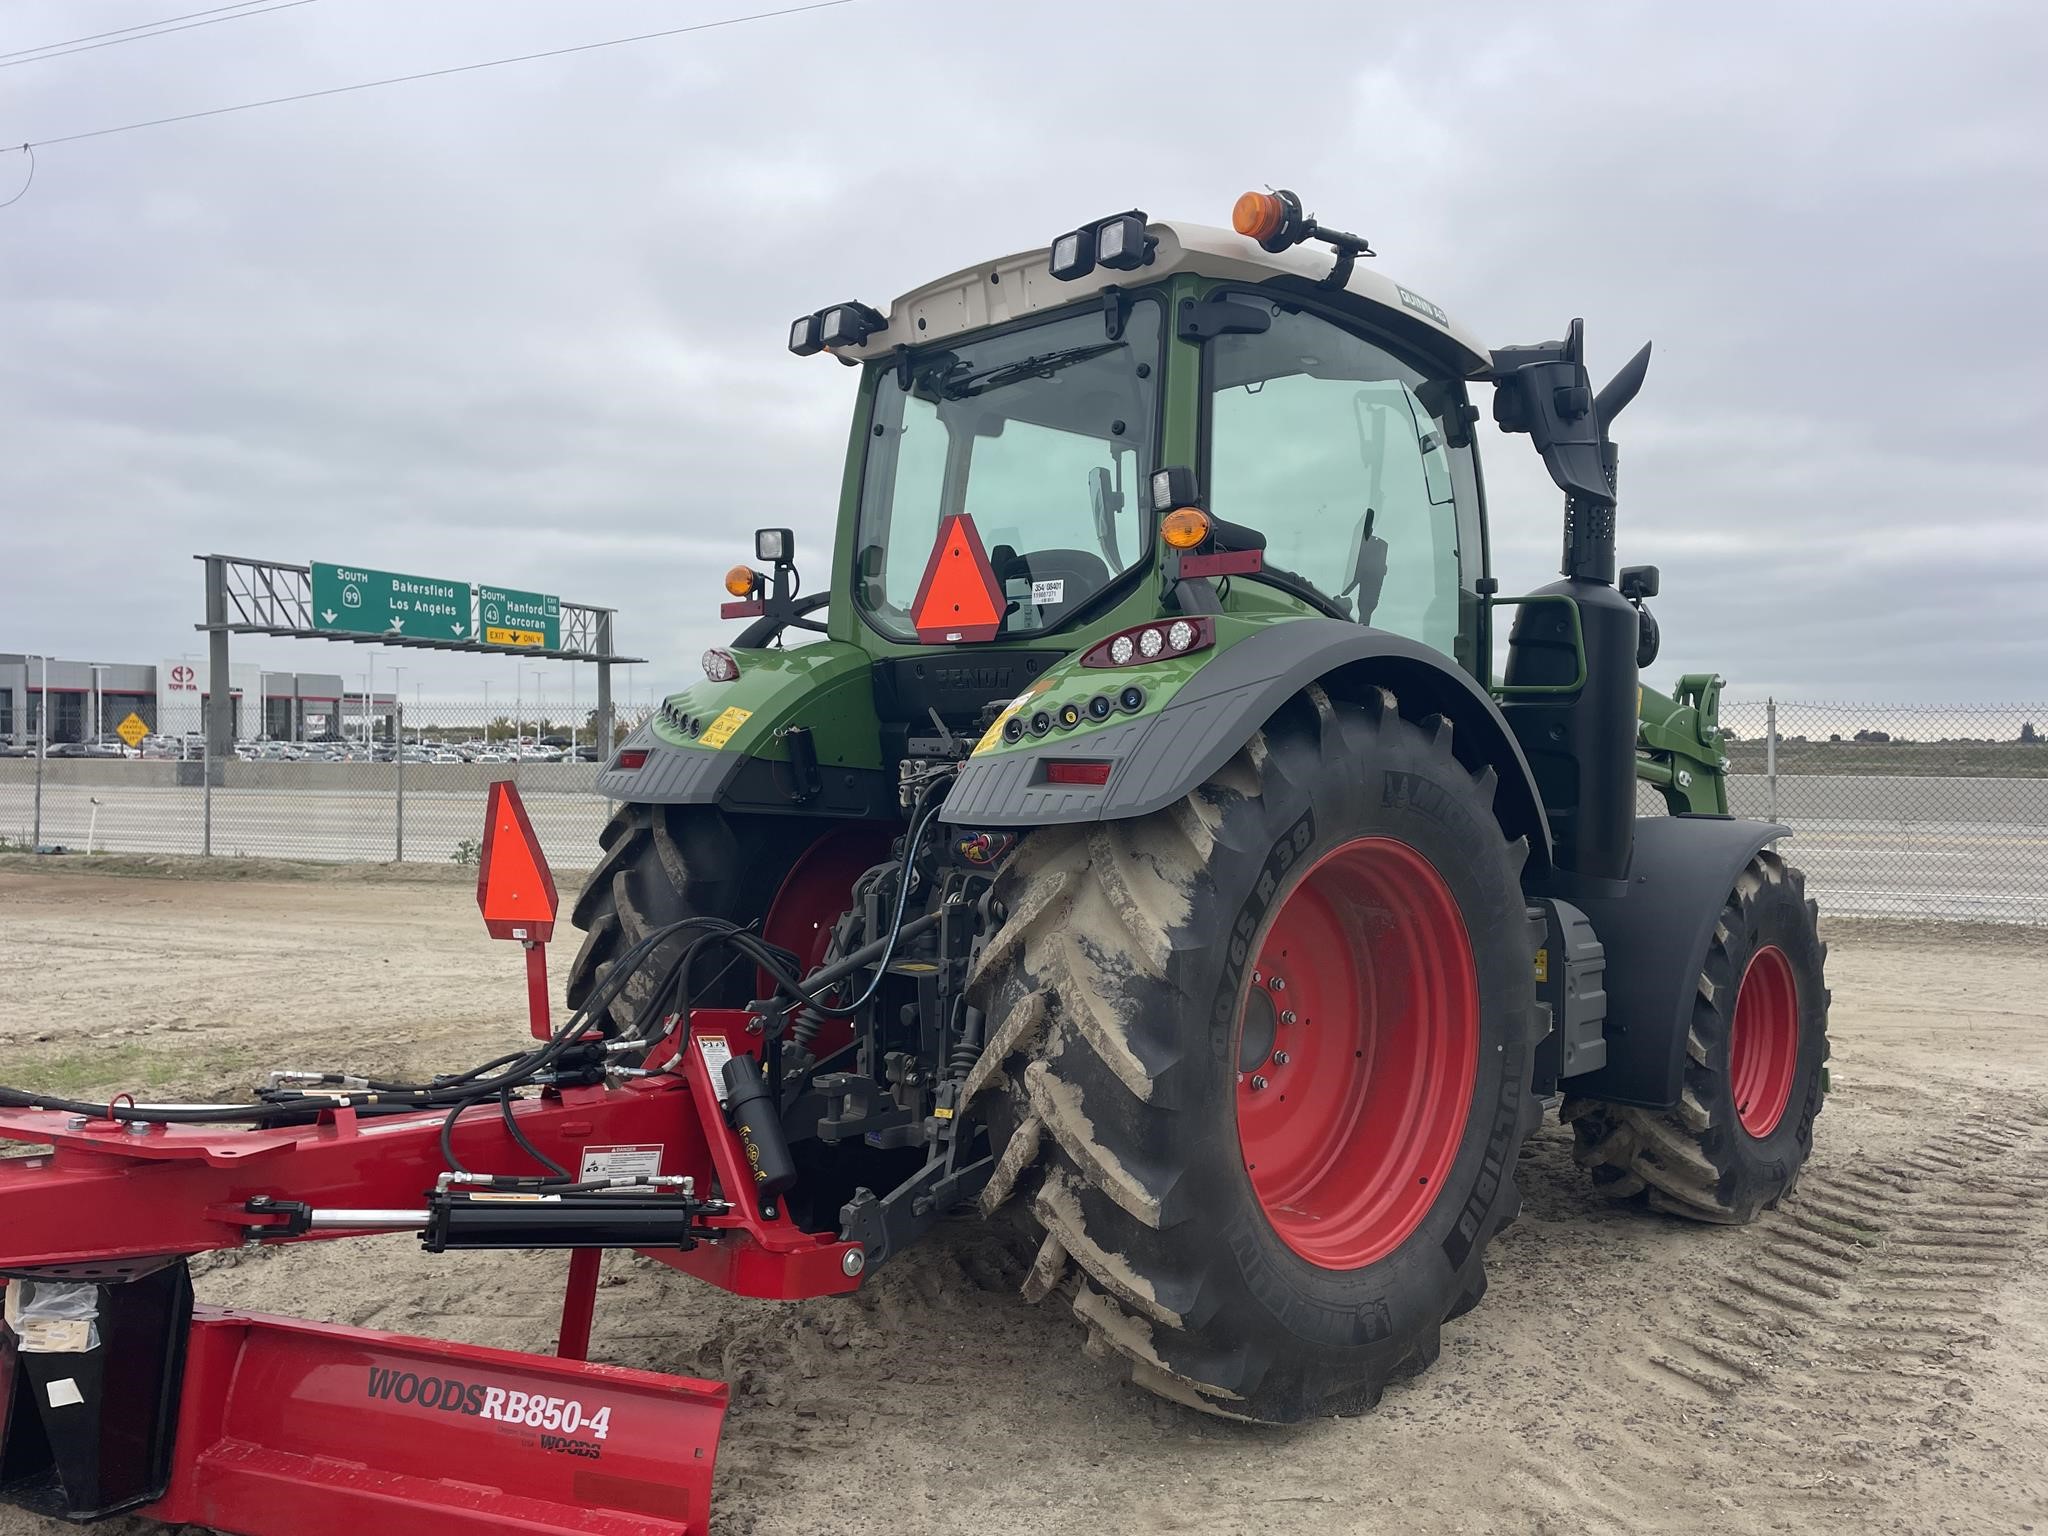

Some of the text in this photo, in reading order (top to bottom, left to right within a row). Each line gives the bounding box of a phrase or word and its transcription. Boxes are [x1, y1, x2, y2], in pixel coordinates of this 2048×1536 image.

[336, 568, 369, 583] SOUTH
[345, 590, 359, 604] 99
[391, 579, 455, 599] Bakersfield
[480, 589, 506, 603] SOUTH
[389, 597, 458, 617] Los Angeles
[506, 600, 544, 616] Hanford
[486, 610, 498, 622] 43
[504, 614, 546, 630] Corcoran
[489, 631, 542, 643] EXIT ONLY
[935, 665, 1014, 691] FENDT
[168, 683, 198, 691] TOYTA
[1274, 819, 1311, 872] 38
[540, 1433, 602, 1460] WOODS
